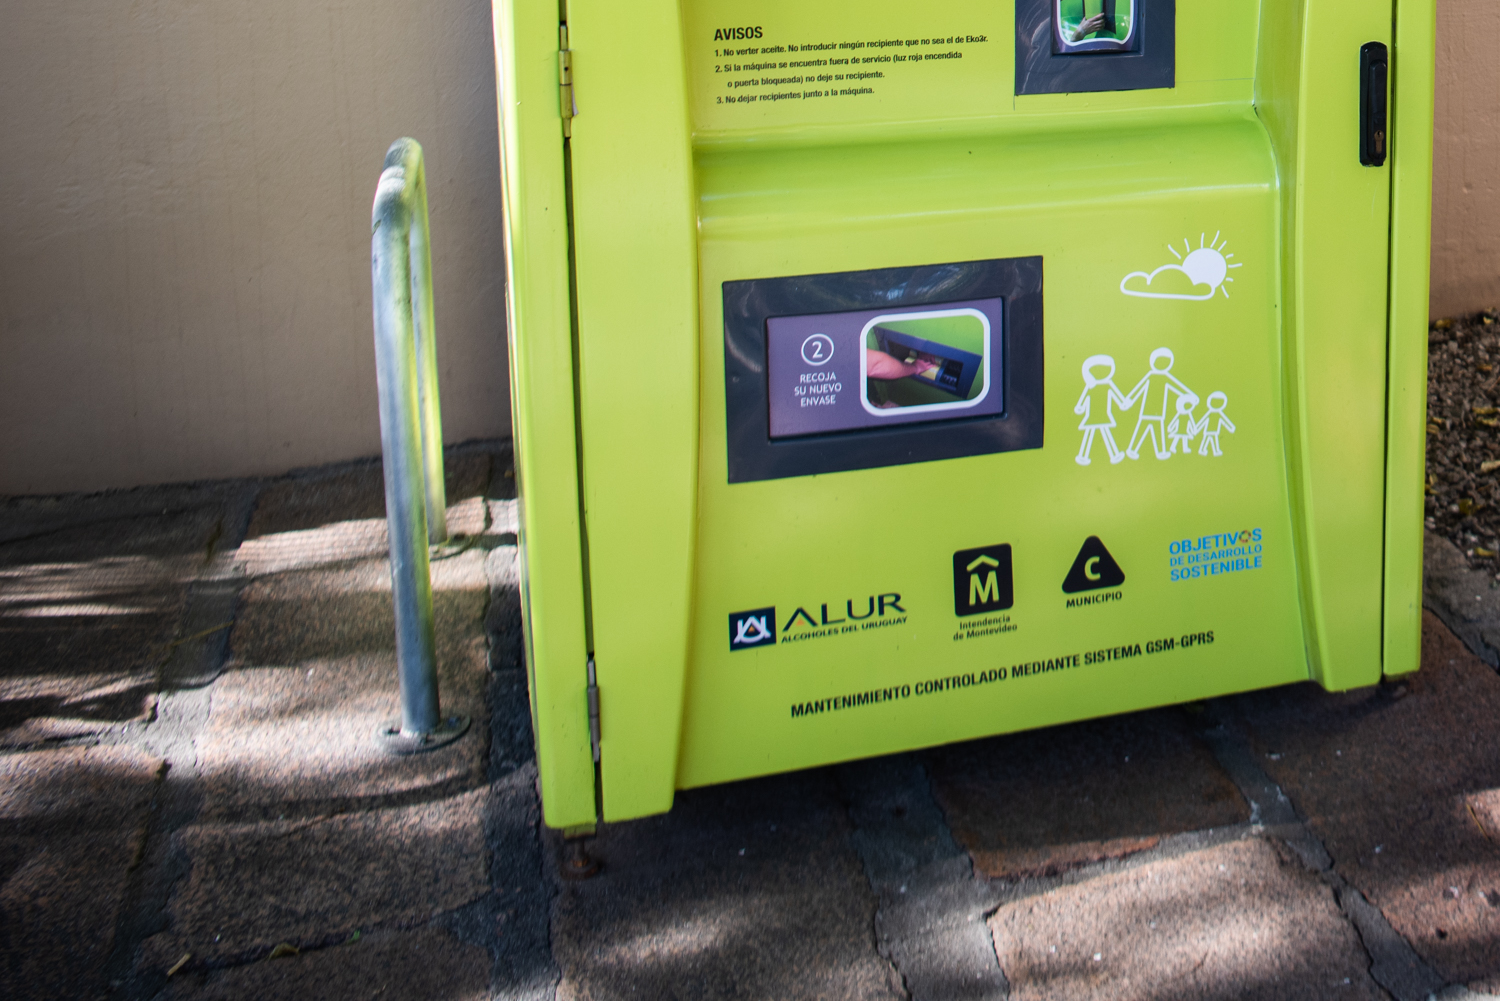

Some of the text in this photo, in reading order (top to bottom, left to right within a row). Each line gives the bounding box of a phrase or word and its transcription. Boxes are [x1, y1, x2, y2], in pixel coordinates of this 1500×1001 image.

[714, 26, 763, 41] AVISOS
[715, 49, 722, 57] 1.
[724, 48, 734, 56] No
[736, 47, 759, 56] verter
[761, 46, 786, 54] aceite.
[788, 44, 798, 53] No
[801, 43, 837, 52] introducir
[839, 41, 865, 52] ningún
[867, 39, 903, 49] recipiente
[905, 39, 919, 47] que
[715, 65, 722, 73] 2.
[724, 64, 732, 72] Si
[734, 63, 741, 72] la
[743, 61, 777, 71] máquina
[790, 59, 827, 68] encuentra
[829, 58, 849, 66] fuera
[851, 57, 860, 65] de
[862, 54, 891, 63] servicio
[893, 53, 906, 63] (luz
[909, 53, 923, 63] roja
[925, 51, 962, 60] encendida
[734, 78, 759, 88] puerta
[761, 76, 803, 87] bloqueada)
[817, 73, 833, 84] deje
[846, 71, 885, 81] recipiente.
[717, 96, 724, 104] 3.
[726, 95, 736, 103] No
[738, 94, 757, 104] dejar
[760, 91, 801, 102] recipientes
[803, 89, 822, 100] junto
[831, 88, 838, 96] la
[840, 87, 874, 96] máquina.
[812, 341, 823, 359] 2
[800, 372, 836, 384] RECOJA
[794, 383, 842, 397] SU NUEVO
[800, 395, 836, 407] ENVASE
[1169, 528, 1262, 555] OBJETIVOS
[1170, 544, 1262, 567] DE DESARROLLO
[1084, 556, 1100, 581] C
[1170, 555, 1262, 582] SOSTENIBLE
[969, 570, 999, 606] M
[1066, 591, 1122, 609] MUNICIPIO
[782, 592, 906, 632] ALUR
[781, 616, 907, 644] ALCOHOLES DEL URUGUAY
[959, 614, 1011, 630] Intendencia
[953, 623, 1018, 641] de Montevideo
[791, 630, 1215, 719] MANTENIMIENTO CONTROLADO MEDIANTE SISTEMA GSM-GPRS
